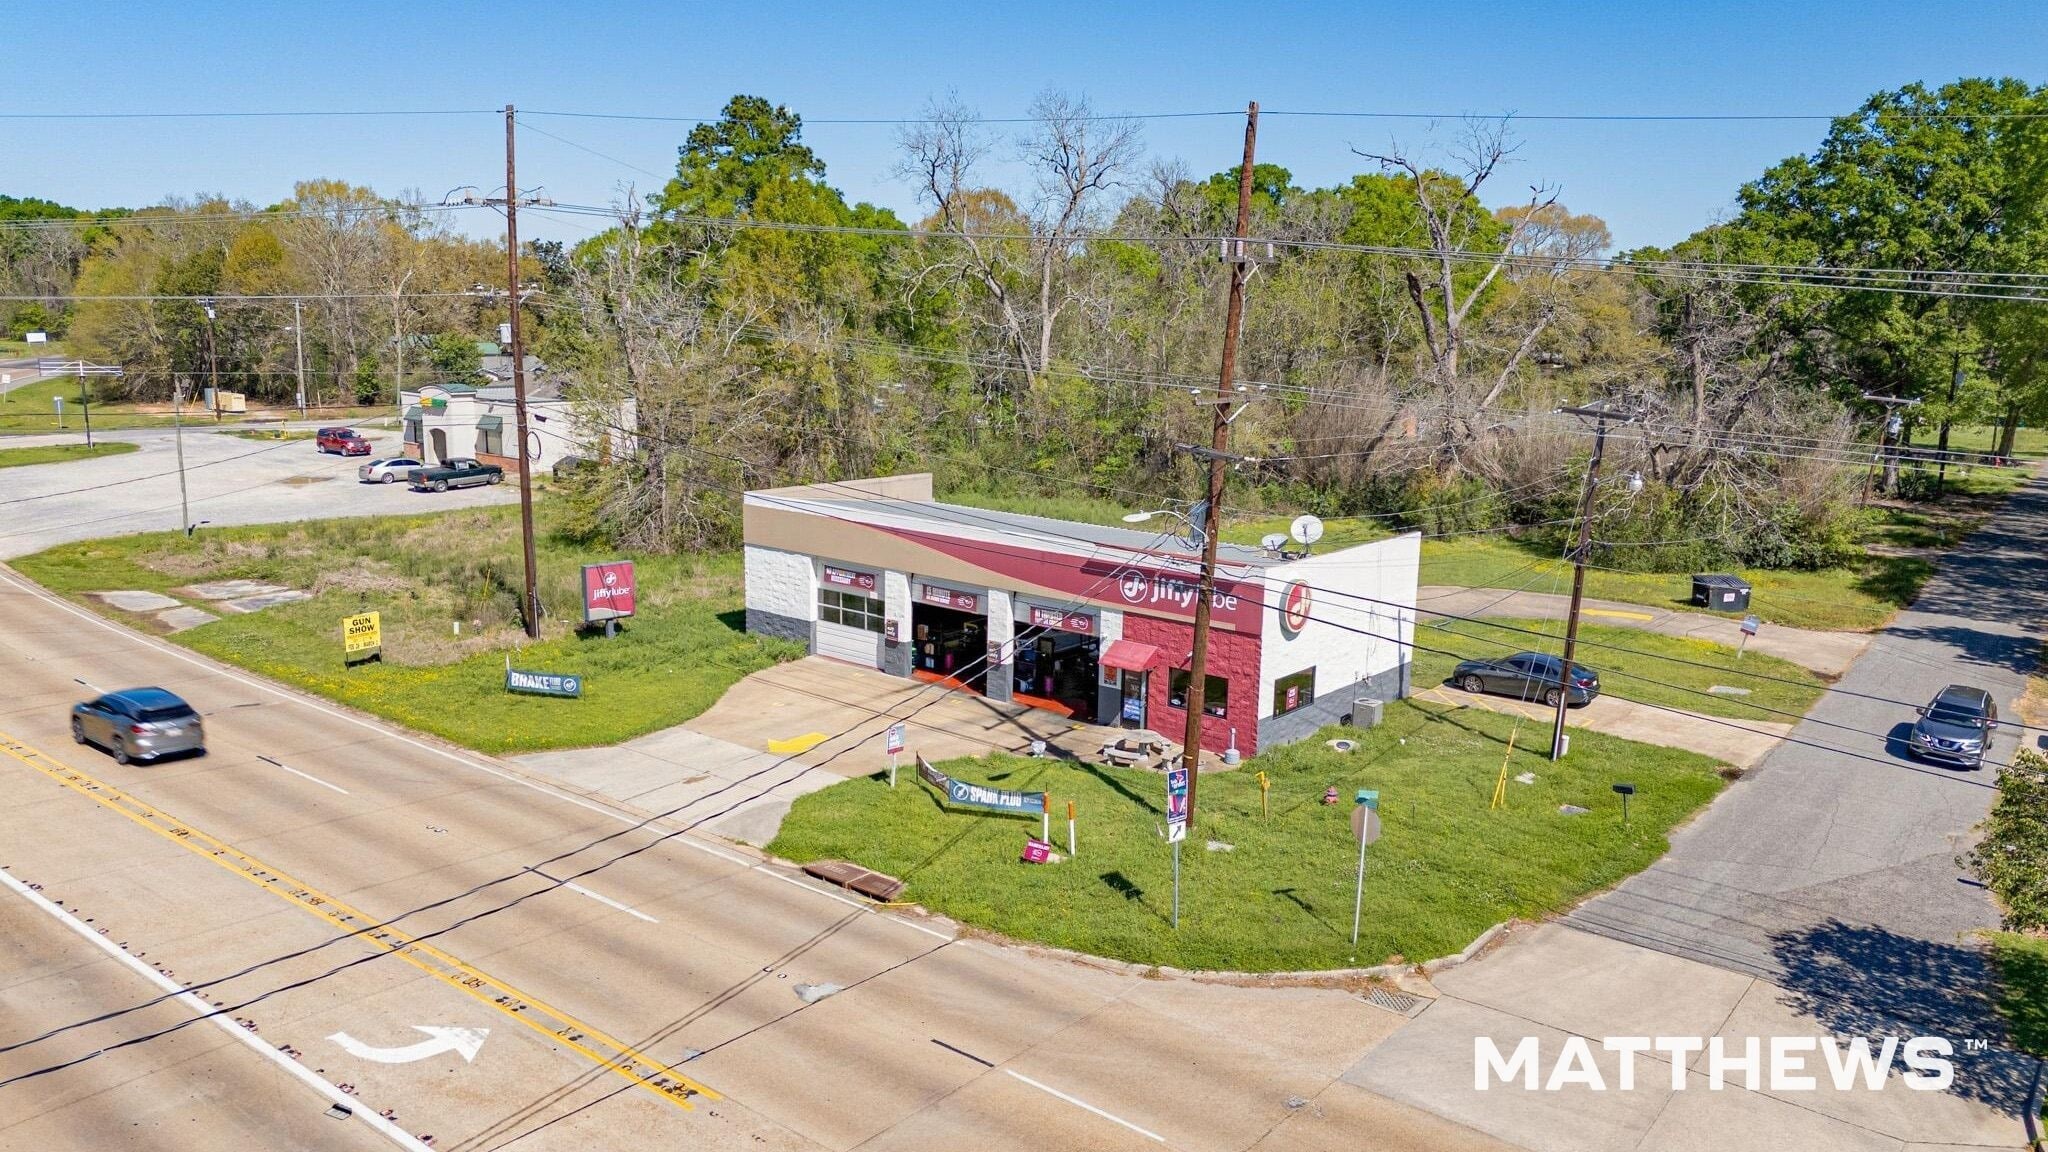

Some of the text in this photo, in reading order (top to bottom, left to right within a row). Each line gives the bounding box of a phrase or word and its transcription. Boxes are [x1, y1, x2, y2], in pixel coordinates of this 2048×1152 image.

[352, 616, 371, 627] GUN
[349, 624, 375, 635] SHOW
[511, 671, 550, 690] BRAKE
[970, 786, 999, 805] SPARK
[1000, 790, 1022, 807] PLUG
